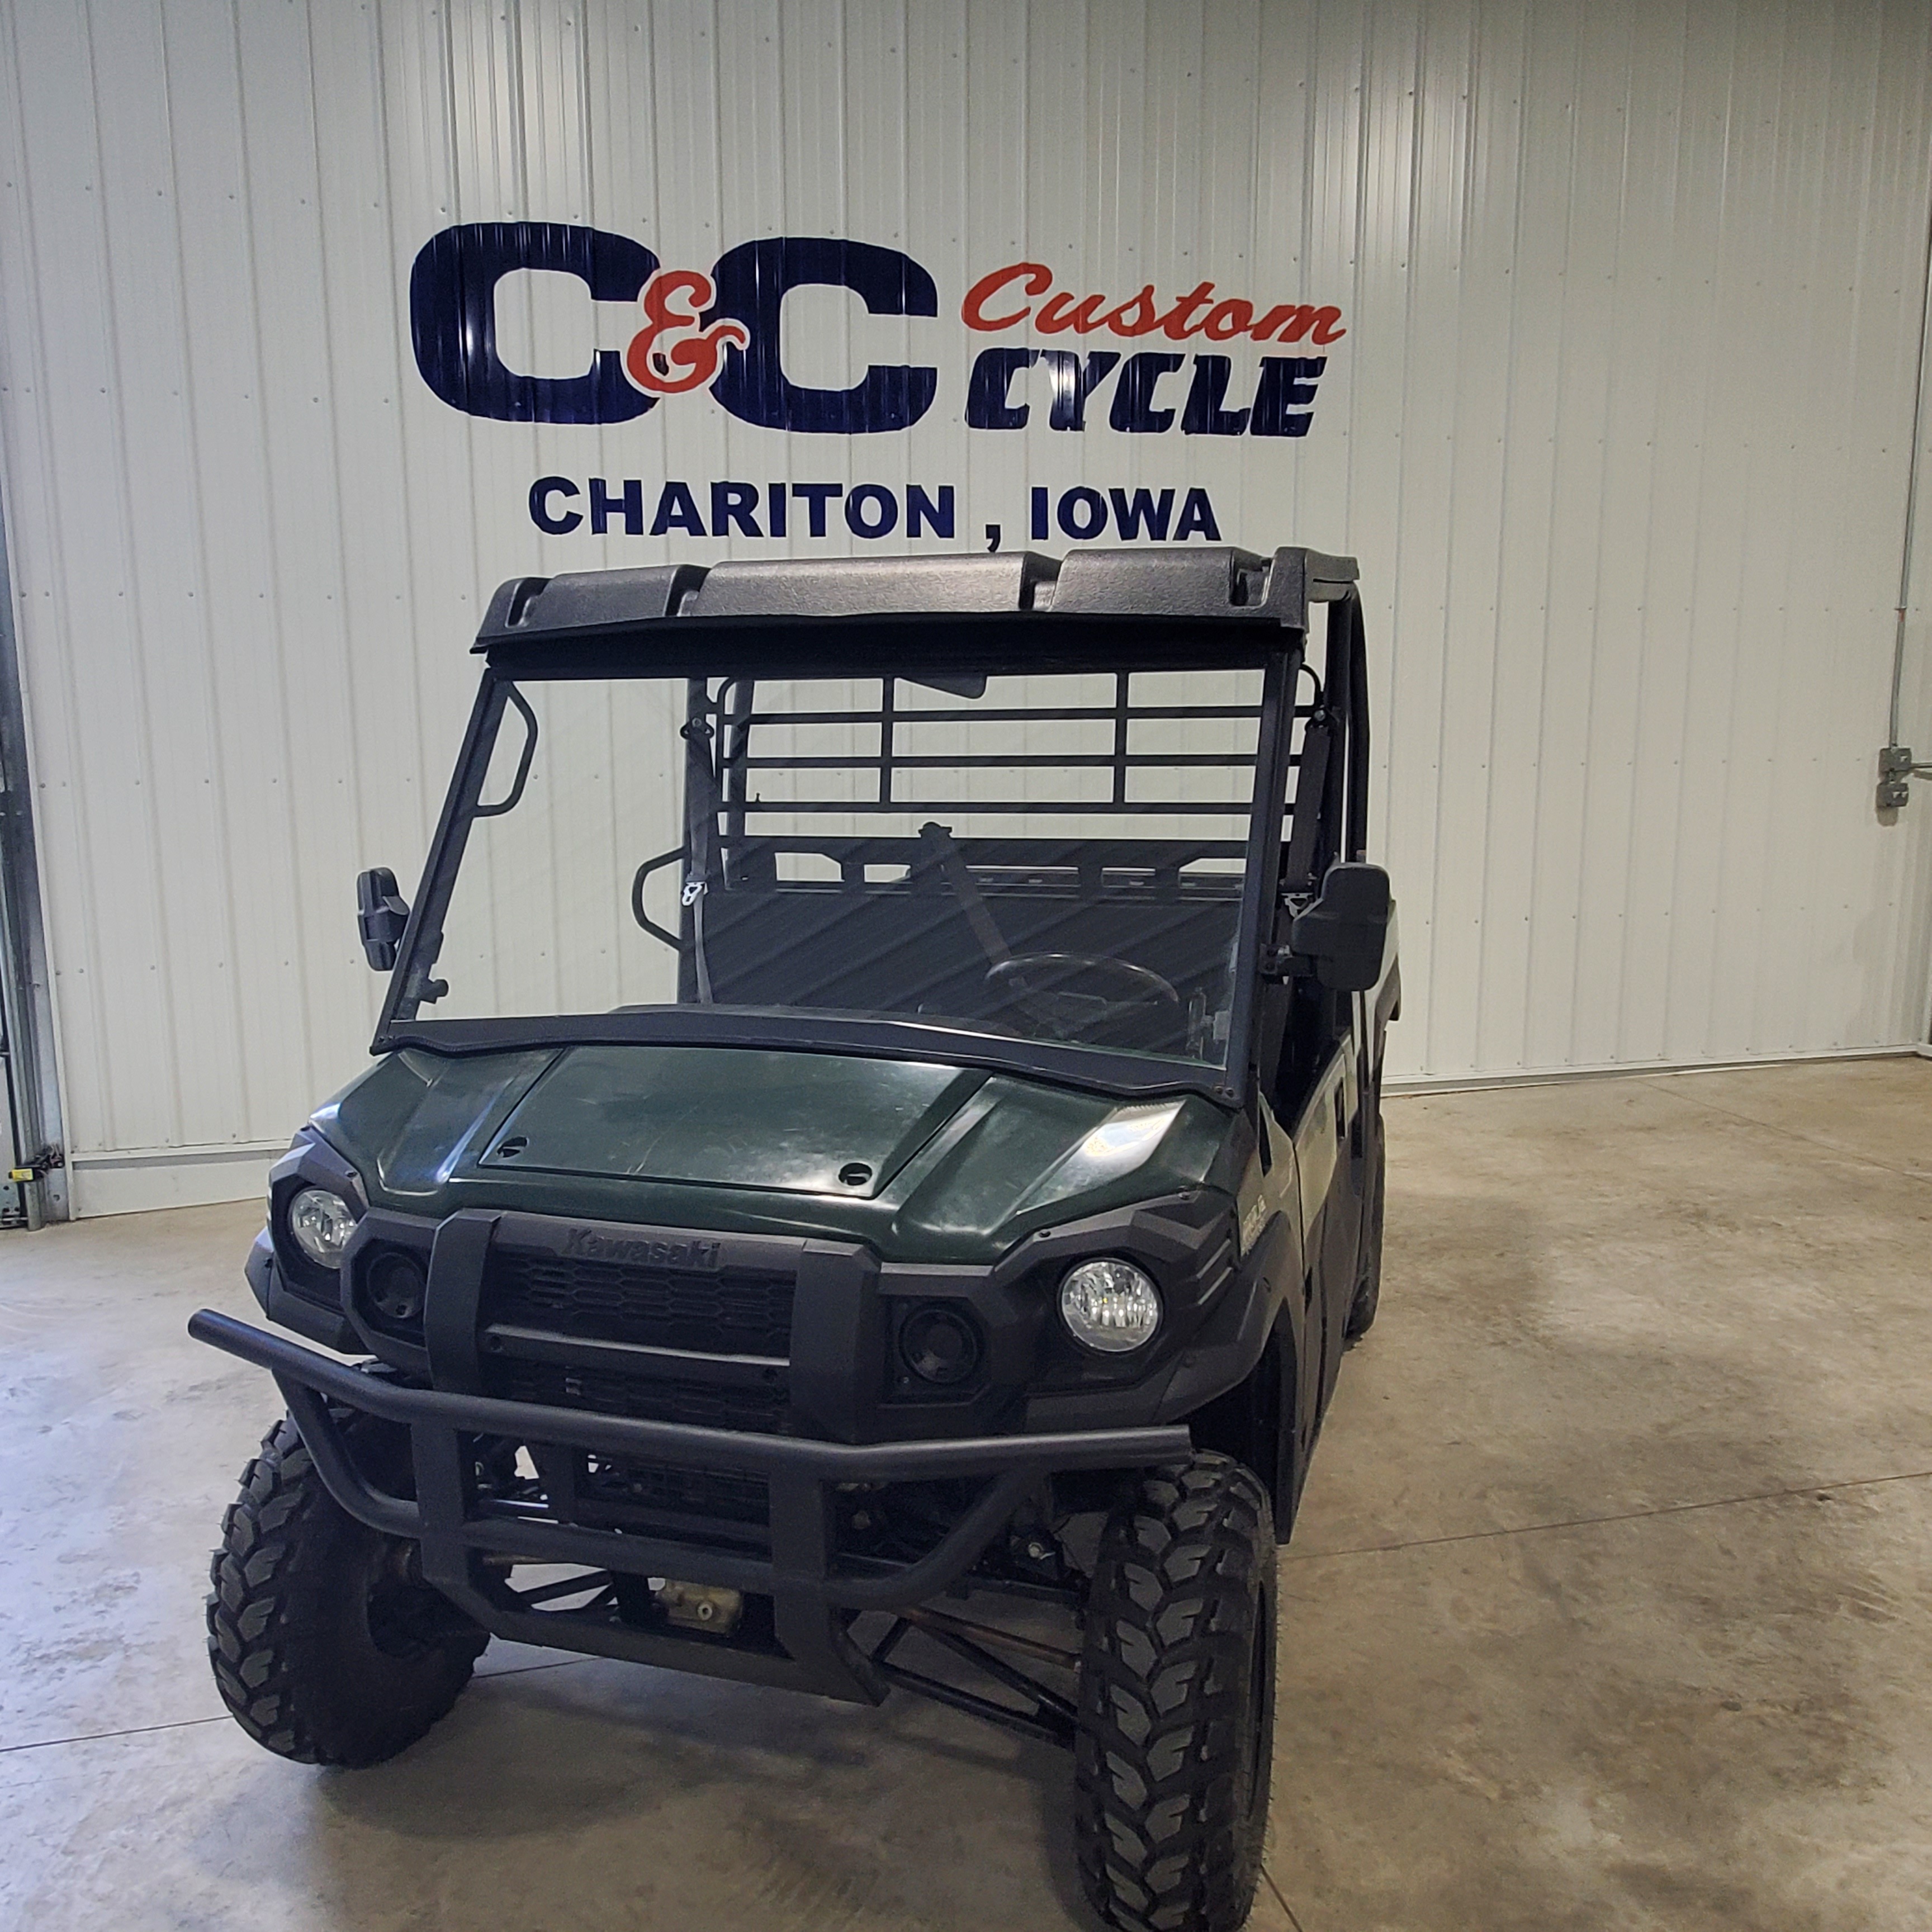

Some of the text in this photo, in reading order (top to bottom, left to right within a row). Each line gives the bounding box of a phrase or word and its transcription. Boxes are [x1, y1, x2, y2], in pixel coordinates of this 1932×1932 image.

[410, 221, 937, 434] C&C
[962, 262, 1347, 345] Custom
[964, 347, 1328, 437] CYCLE
[528, 476, 955, 539] CHARITON
[1031, 486, 1222, 541] IOWA
[563, 1227, 721, 1270] Kawasaki
